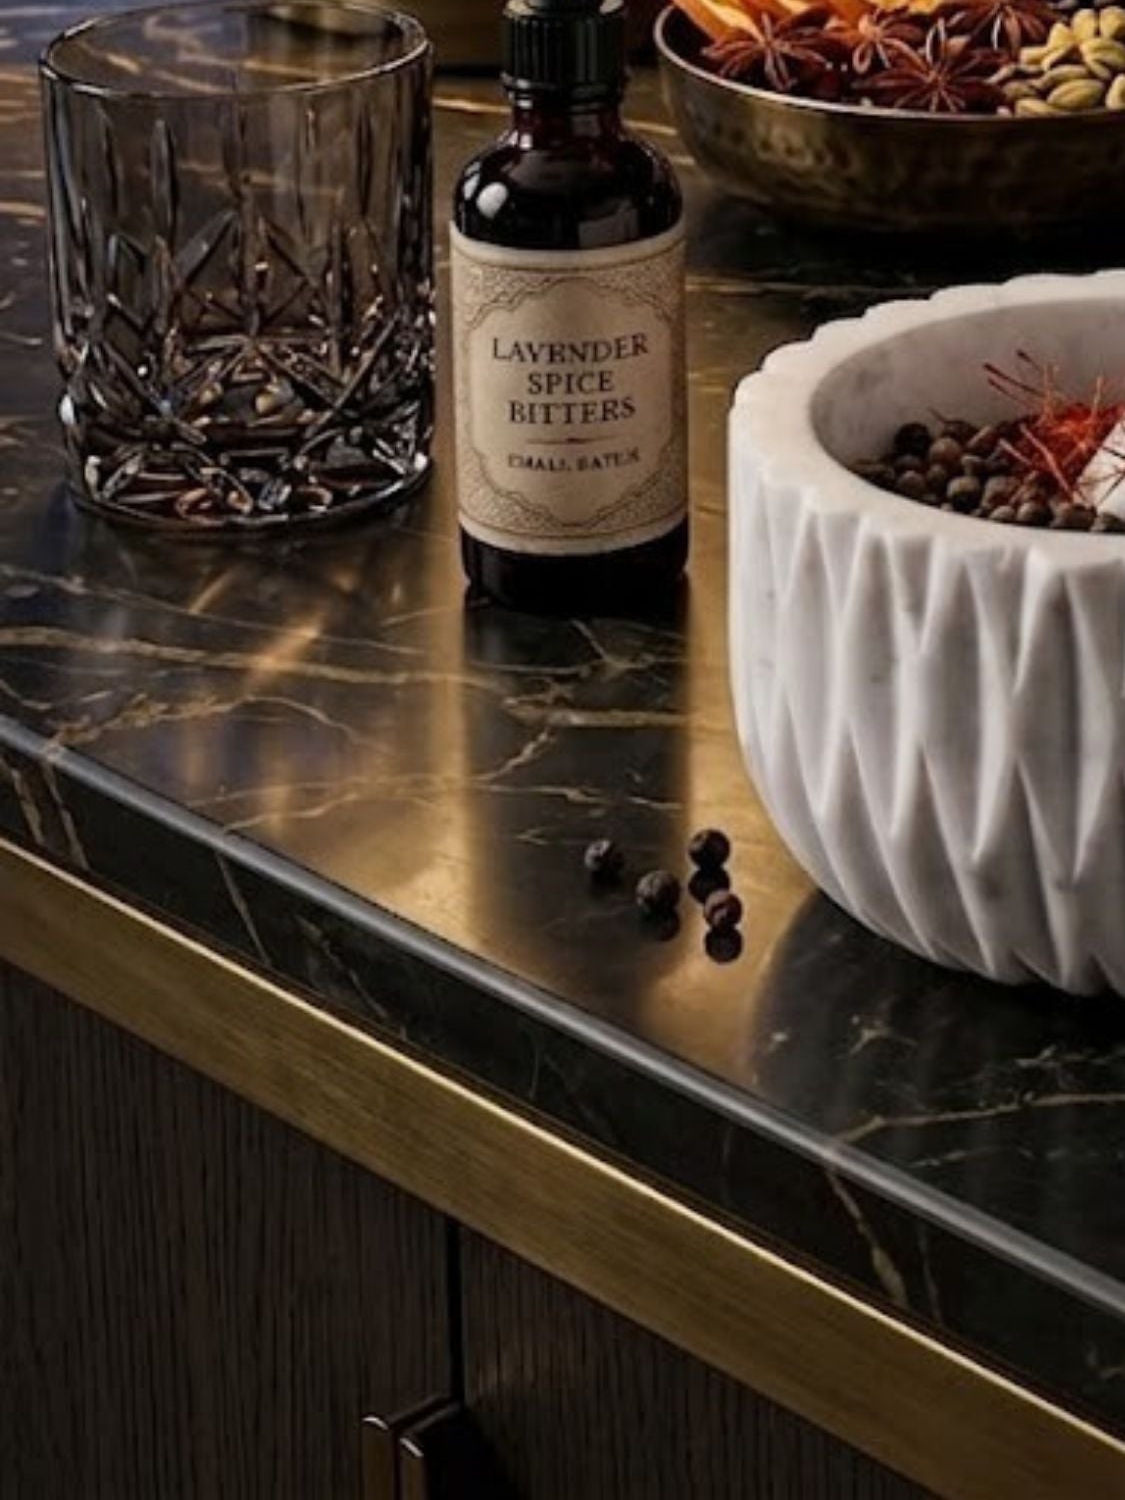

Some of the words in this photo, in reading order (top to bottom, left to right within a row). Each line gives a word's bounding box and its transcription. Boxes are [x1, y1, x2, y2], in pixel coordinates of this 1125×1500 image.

[493, 332, 649, 364] LAVENDER
[528, 371, 614, 395] SPICE
[509, 396, 636, 425] BITTERS
